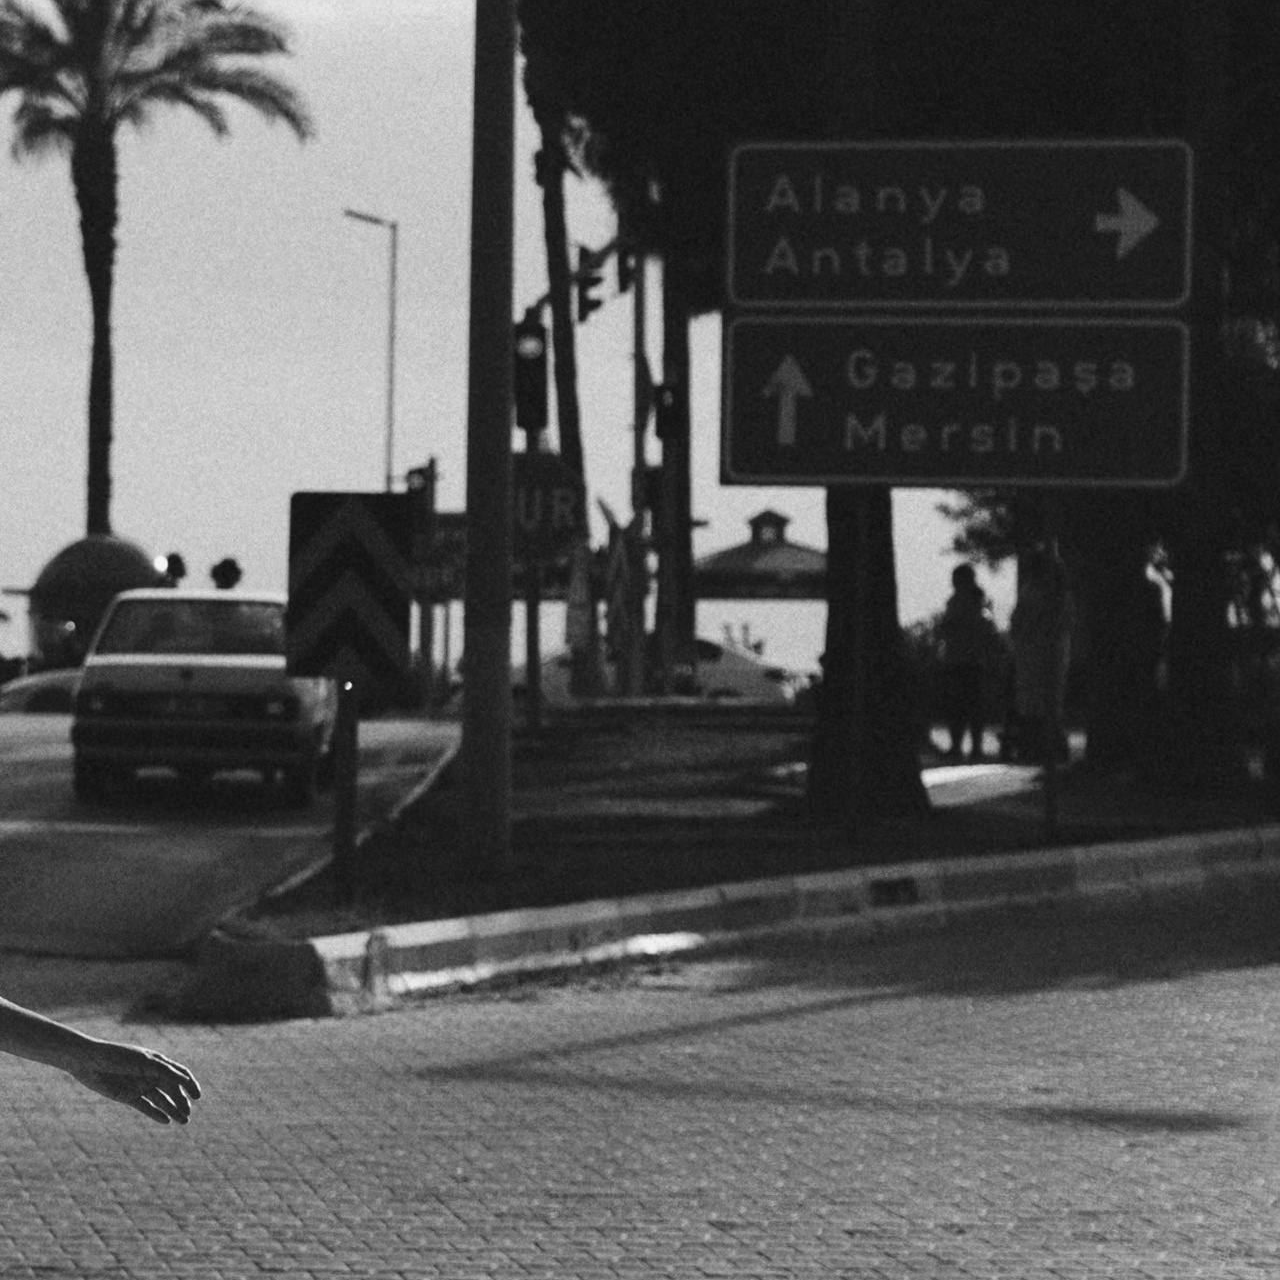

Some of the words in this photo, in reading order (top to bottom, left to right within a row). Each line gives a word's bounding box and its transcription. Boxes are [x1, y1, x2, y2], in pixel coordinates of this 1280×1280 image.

[766, 174, 984, 224] Alanya
[765, 236, 1009, 287] Antalya
[844, 411, 1062, 454] Mersin
[517, 485, 577, 531] UR
